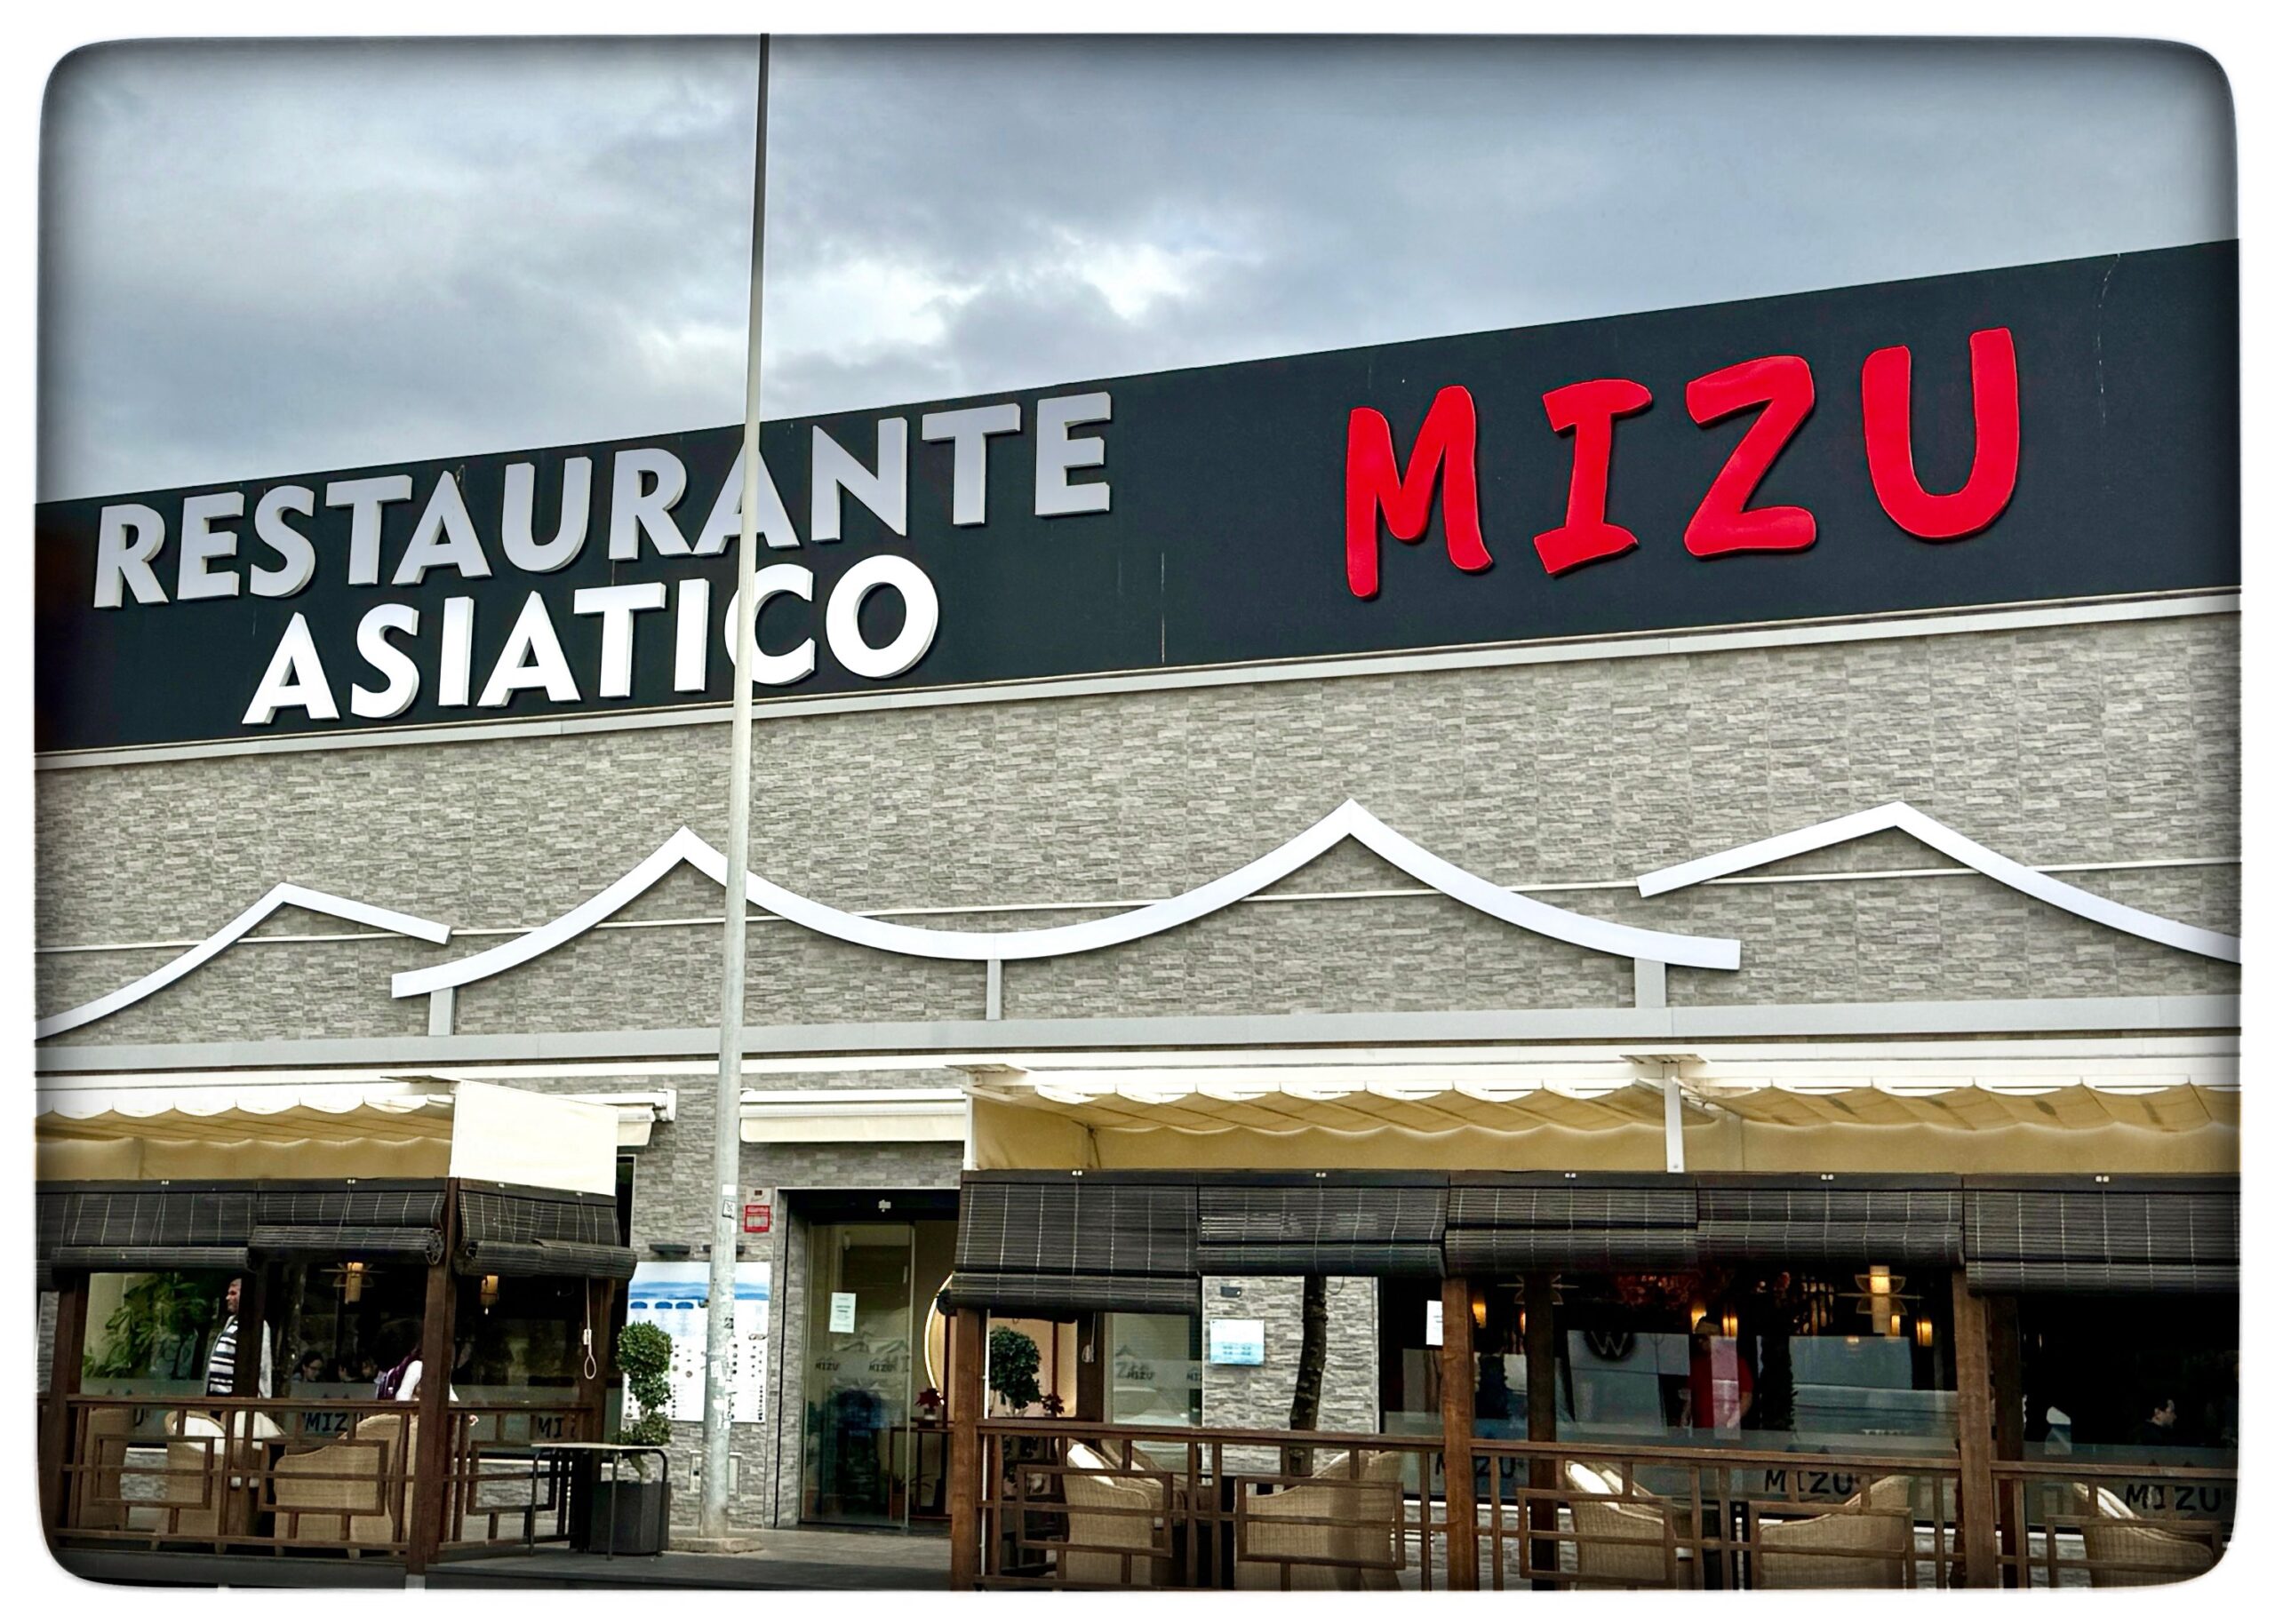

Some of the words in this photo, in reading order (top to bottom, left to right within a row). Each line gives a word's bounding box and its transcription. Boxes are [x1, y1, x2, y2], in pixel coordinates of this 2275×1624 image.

[93, 391, 1112, 609] RESTAURANTE
[1345, 327, 2021, 599] MIZU
[242, 554, 939, 725] ASIATICO
[2125, 1484, 2222, 1512] MIZU
